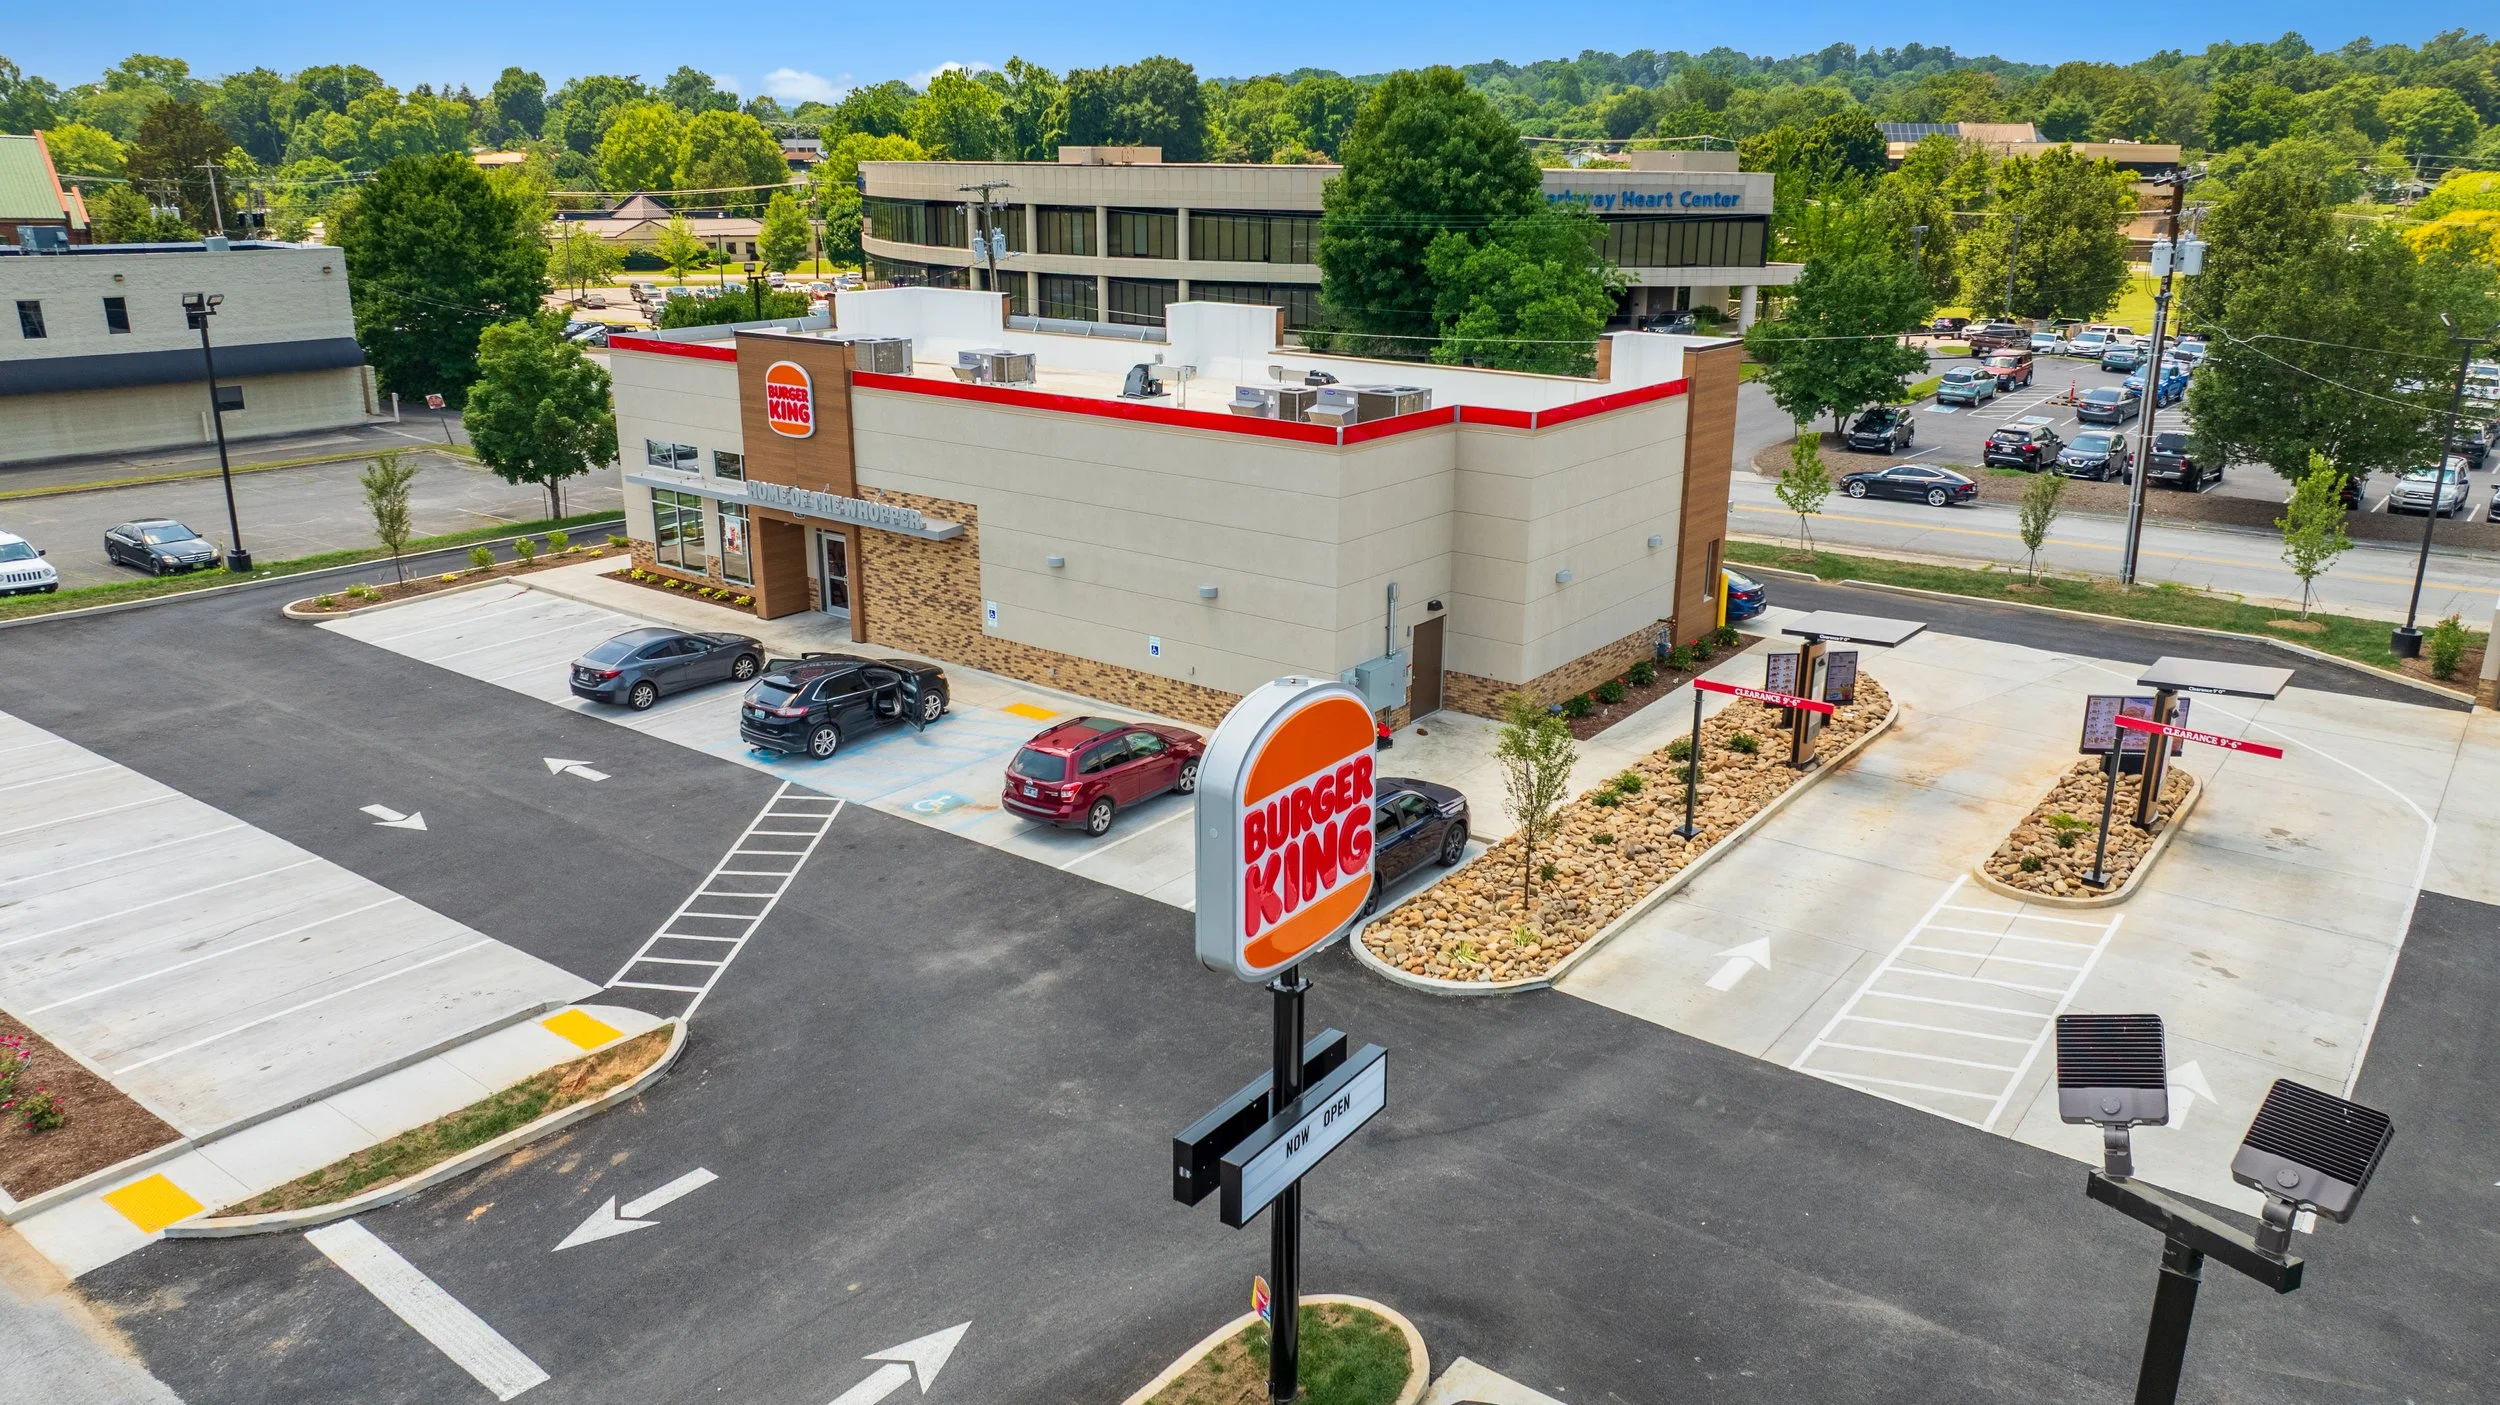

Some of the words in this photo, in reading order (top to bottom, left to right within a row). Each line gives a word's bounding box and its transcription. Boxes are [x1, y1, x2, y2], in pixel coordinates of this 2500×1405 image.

[1546, 188, 1616, 211] arkway
[1622, 190, 1673, 208] Heart
[1680, 190, 1741, 208] Center
[767, 384, 809, 403] BURGER
[768, 399, 811, 424] KING
[747, 479, 788, 505] HOME
[789, 487, 810, 508] OF
[810, 491, 843, 515] THE
[843, 497, 923, 530] WHOPPER
[1734, 687, 1781, 703] CLEARANCE
[1782, 696, 1801, 707] 9'-6"
[2162, 727, 2218, 745] CLEARANCE
[2220, 738, 2242, 749] 9'-6"
[1244, 753, 1374, 865] BURGER
[1244, 803, 1373, 938] KING
[1286, 1124, 1310, 1159] NOW
[1323, 1093, 1351, 1128] OPEN
